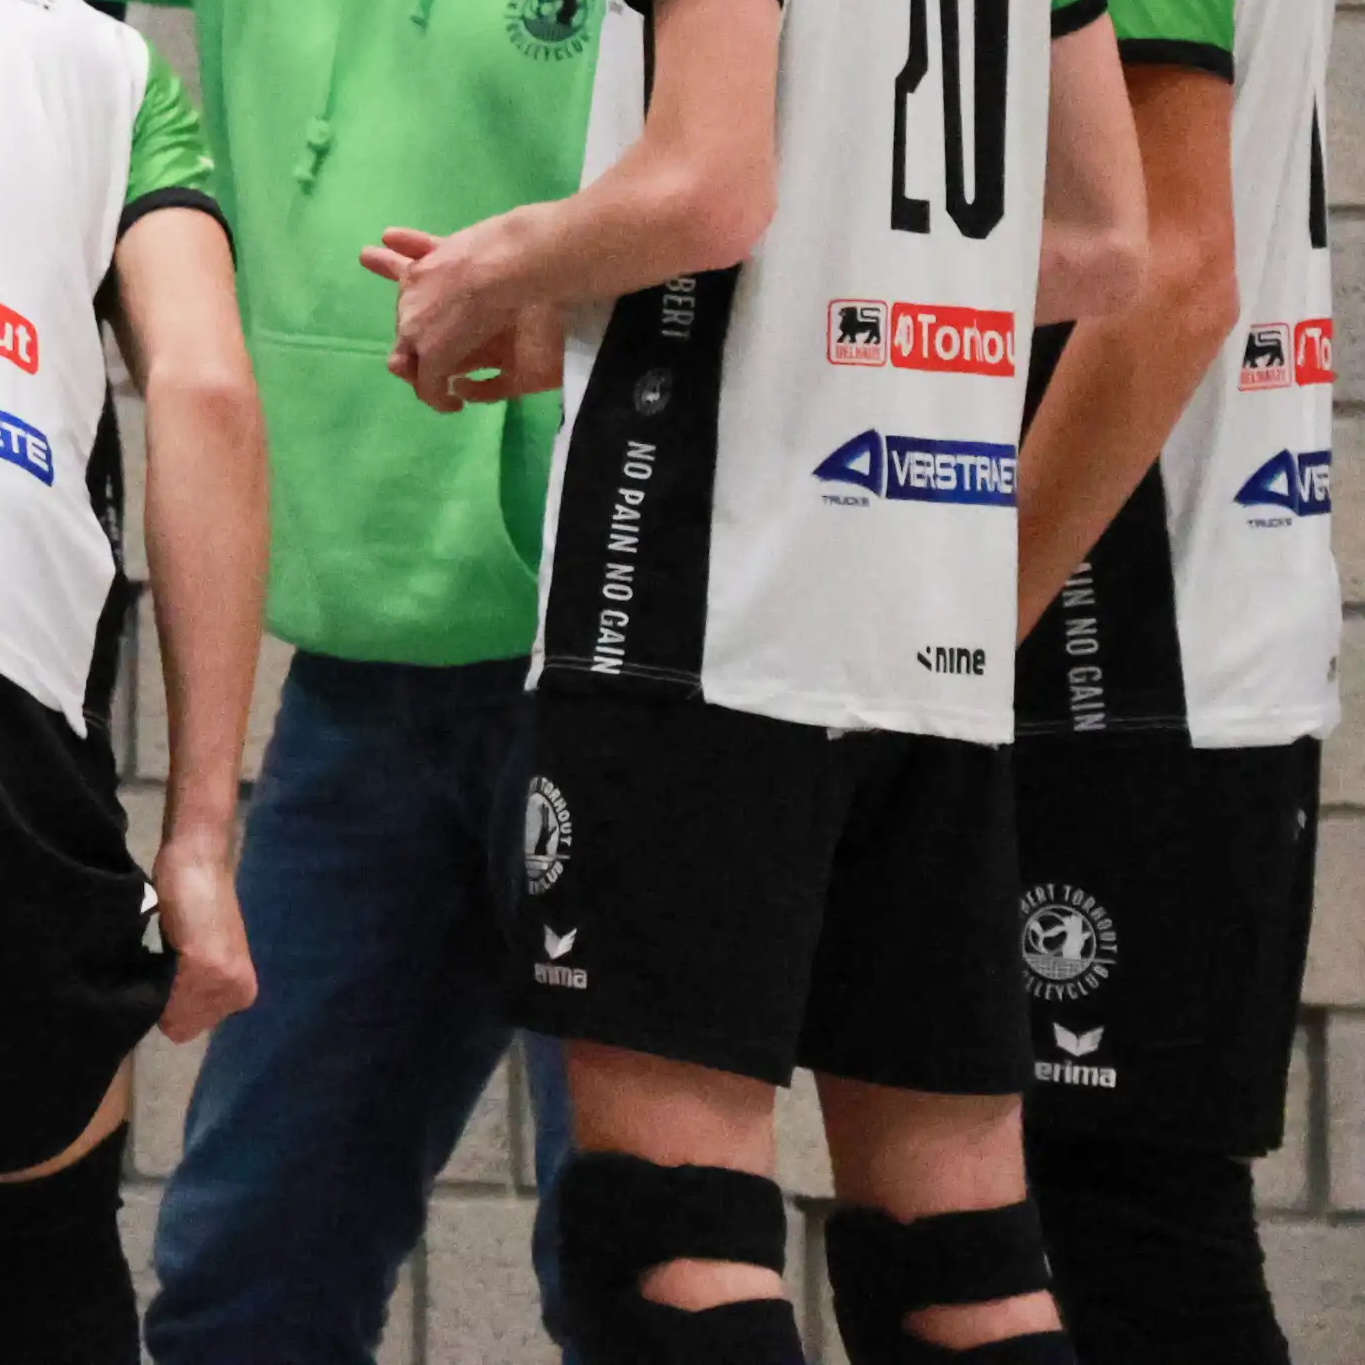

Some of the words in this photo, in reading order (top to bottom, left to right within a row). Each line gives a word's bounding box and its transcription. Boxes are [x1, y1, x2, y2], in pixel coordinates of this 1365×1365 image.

[623, 440, 657, 481] NO
[607, 487, 646, 554] PAIN
[602, 562, 635, 602] NO
[589, 608, 630, 676] GAIN
[1066, 617, 1100, 657] NO
[934, 644, 986, 676] nine
[1067, 665, 1107, 732] GAIN
[1033, 1060, 1117, 1088] erima
